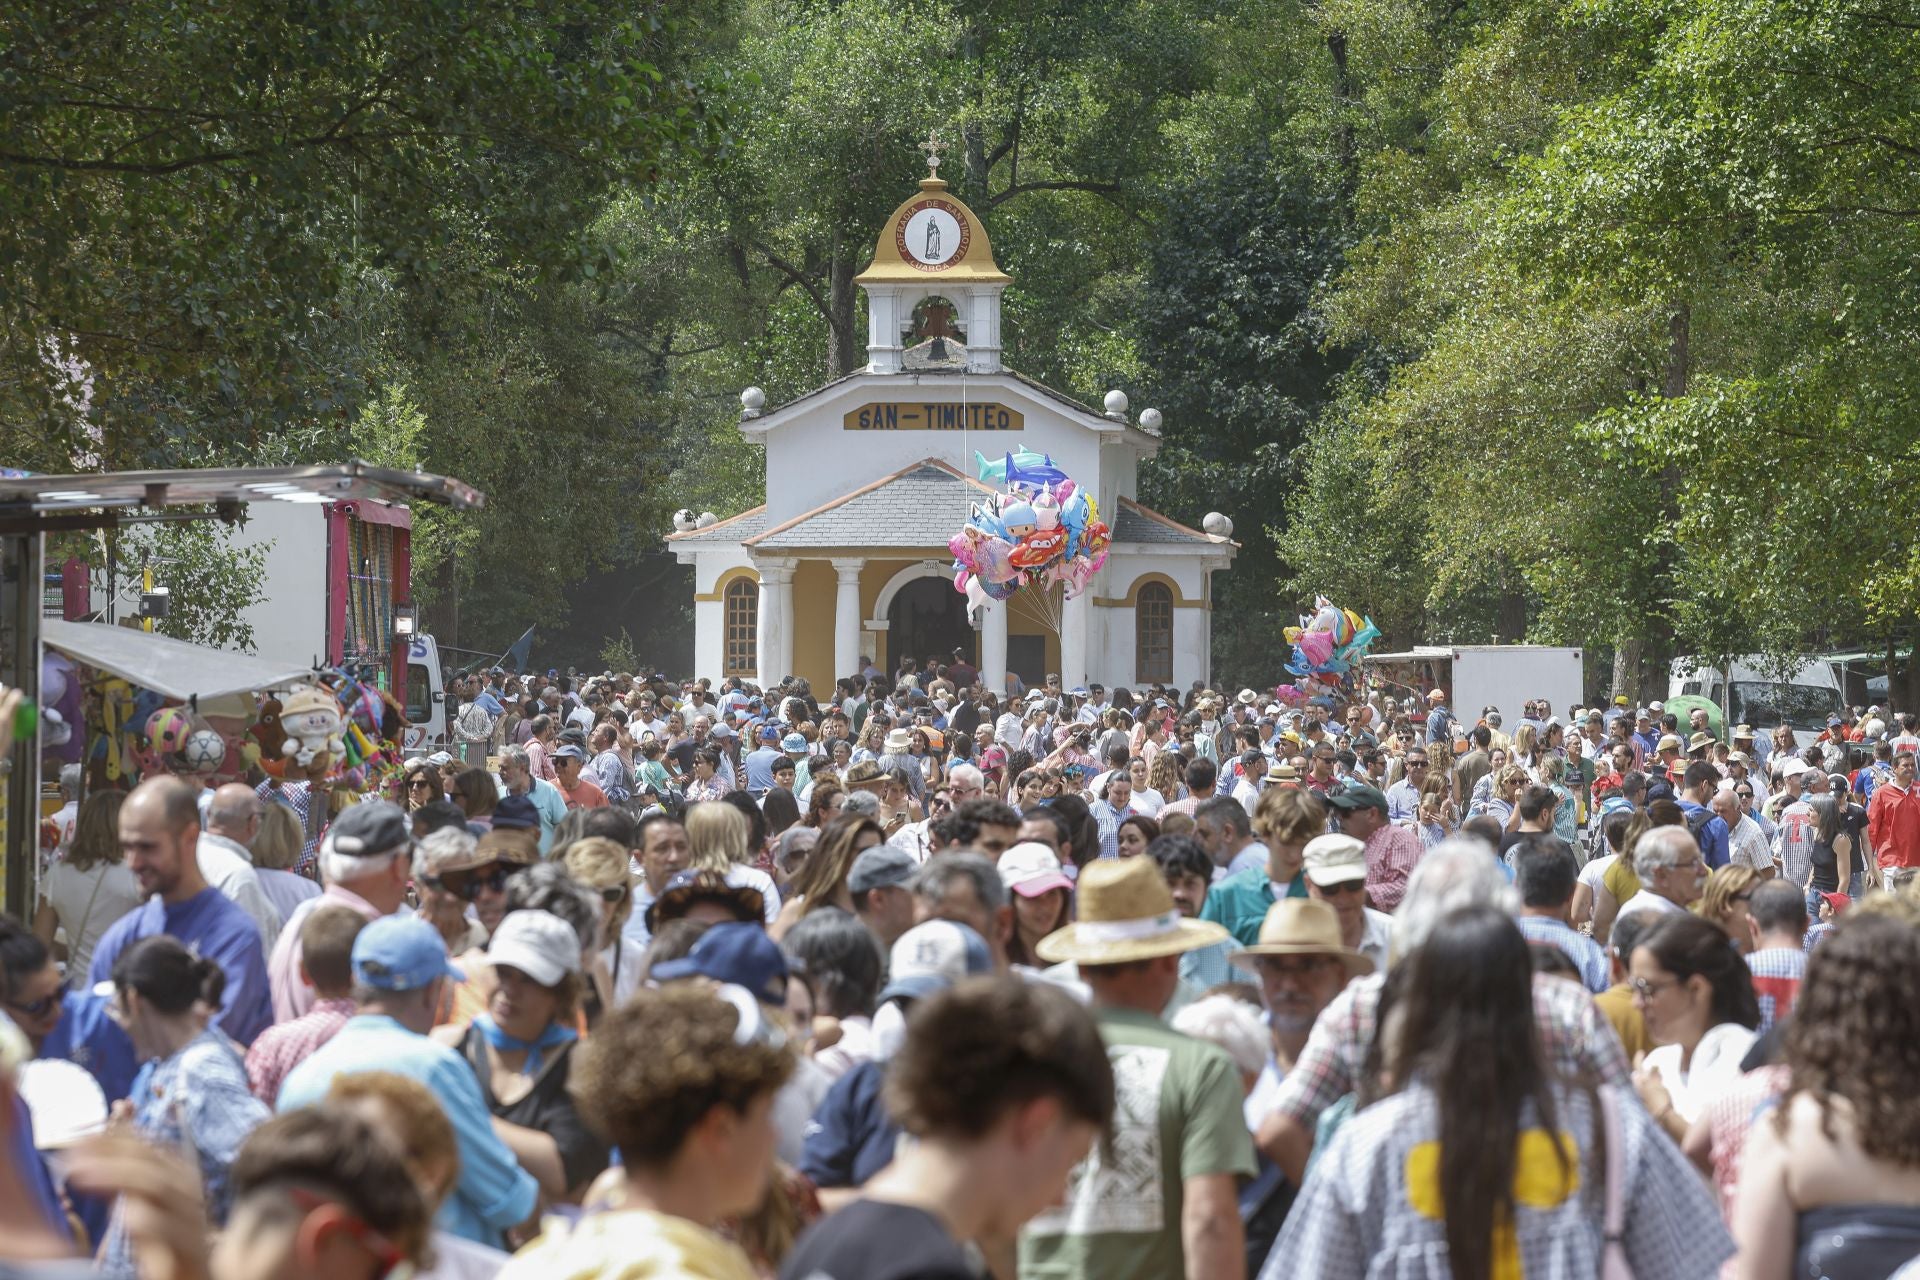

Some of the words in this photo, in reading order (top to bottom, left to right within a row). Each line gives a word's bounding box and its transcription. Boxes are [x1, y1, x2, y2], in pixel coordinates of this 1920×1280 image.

[926, 200, 939, 208] DE
[945, 203, 961, 220] SAN
[952, 221, 970, 263] TIMOTEO
[910, 261, 950, 271] LUARCA
